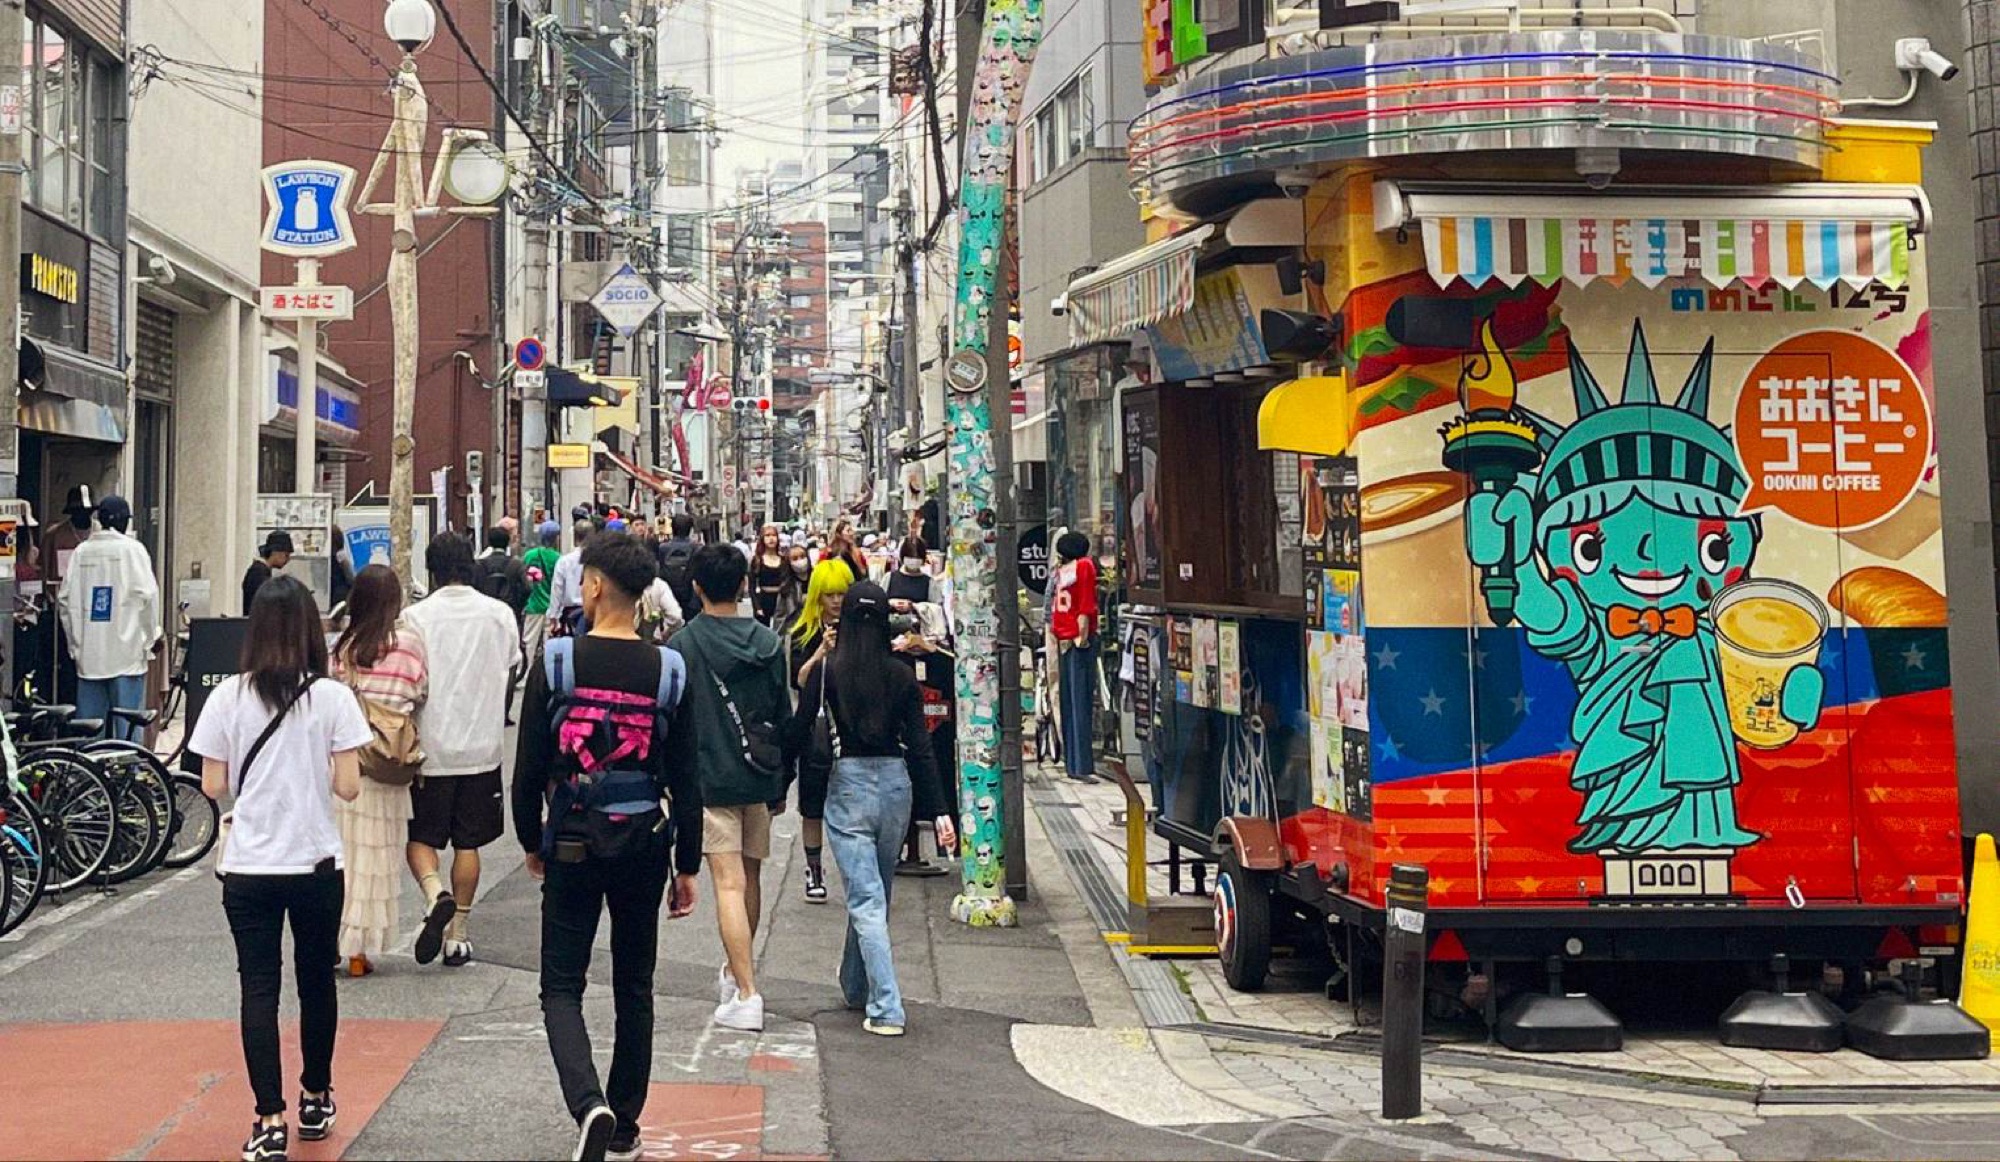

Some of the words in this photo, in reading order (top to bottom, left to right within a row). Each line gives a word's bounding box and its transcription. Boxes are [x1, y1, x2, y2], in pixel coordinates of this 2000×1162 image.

[277, 174, 337, 188] LAWSON
[277, 229, 335, 242] STATION
[606, 290, 649, 300] SOCIO
[1759, 376, 1903, 422] おおきに
[1760, 425, 1904, 472] コーヒー
[1763, 475, 1818, 491] OOKINI
[1823, 475, 1881, 491] COFFEE
